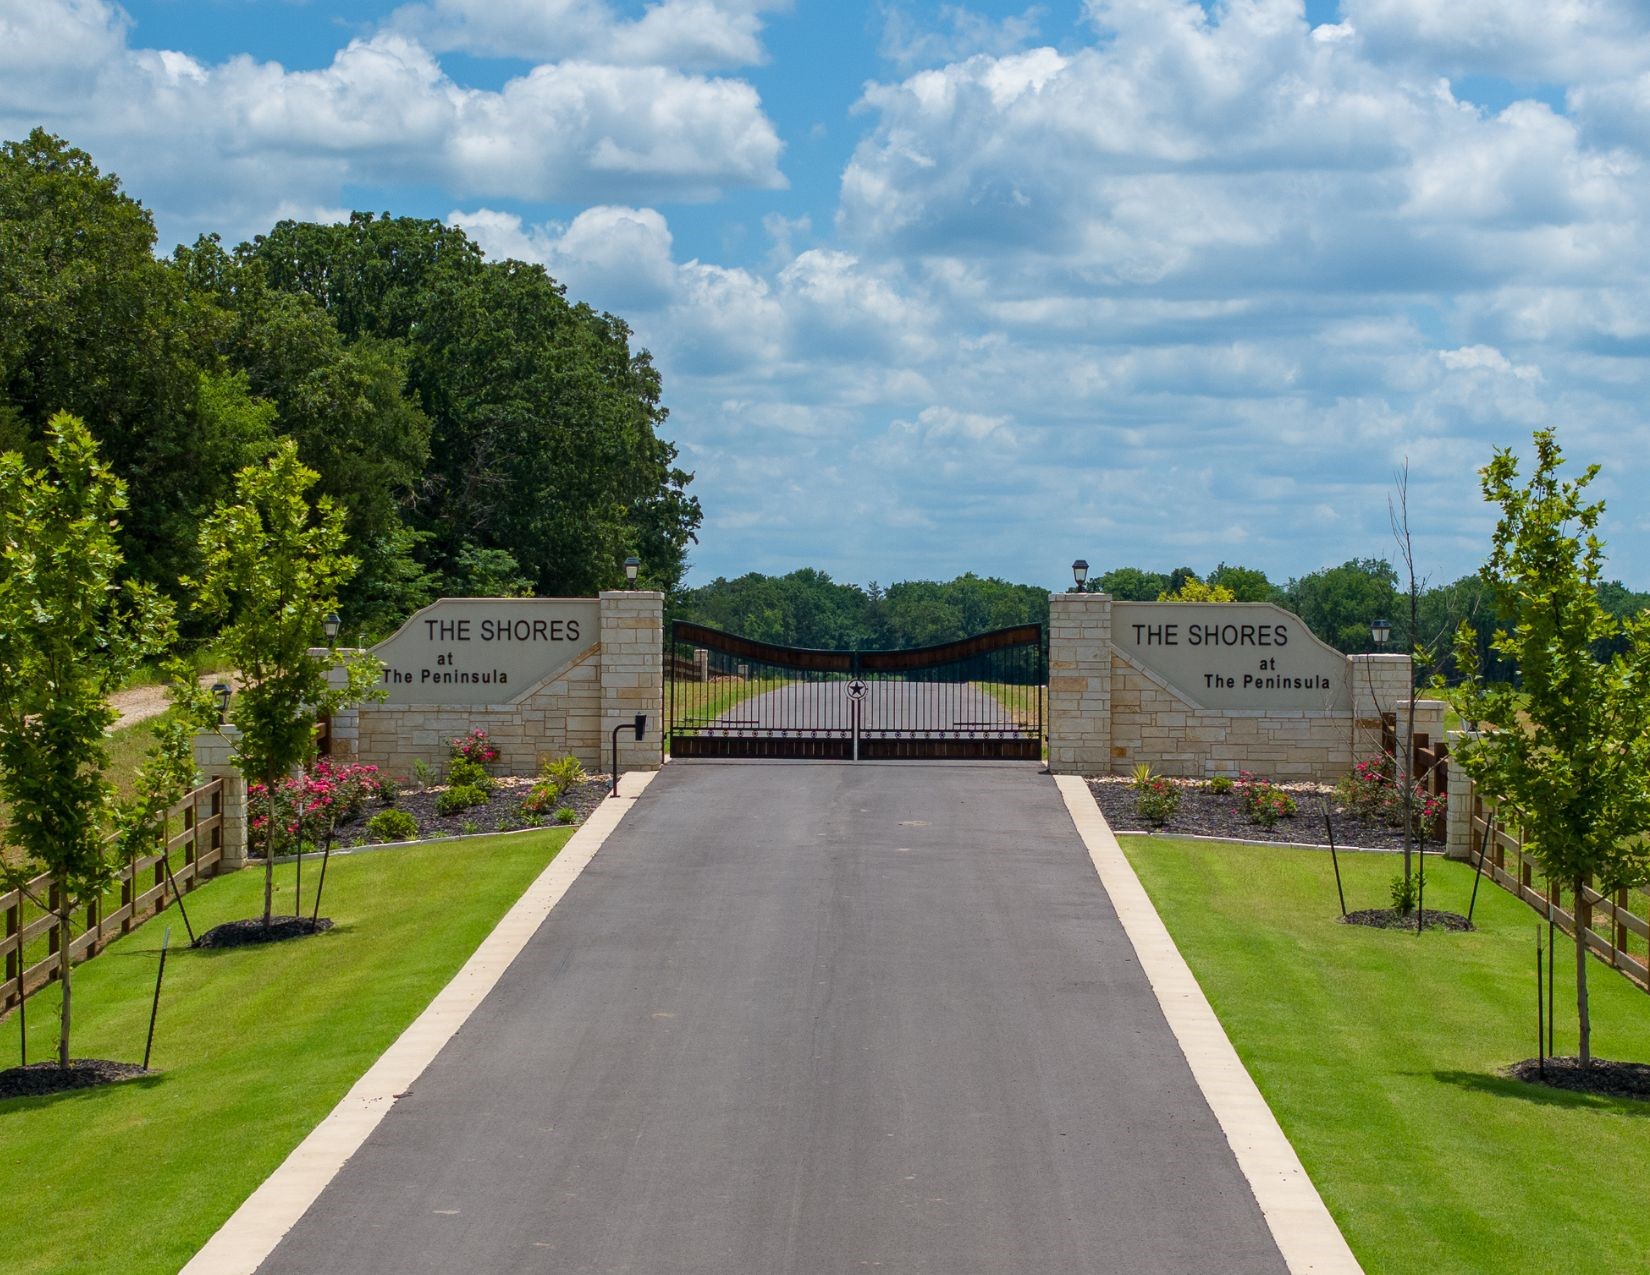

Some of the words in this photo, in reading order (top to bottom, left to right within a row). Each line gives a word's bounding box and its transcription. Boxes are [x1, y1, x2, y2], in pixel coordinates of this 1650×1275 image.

[425, 620, 471, 641] THE
[480, 619, 580, 641] SHORES
[1132, 624, 1178, 645] THE
[1188, 624, 1288, 646] SHORES
[437, 652, 453, 665] at
[1259, 657, 1275, 671] at
[382, 669, 413, 683] The
[421, 669, 508, 684] Peninsula
[1204, 674, 1235, 688] The
[1243, 674, 1330, 689] Peninsula
